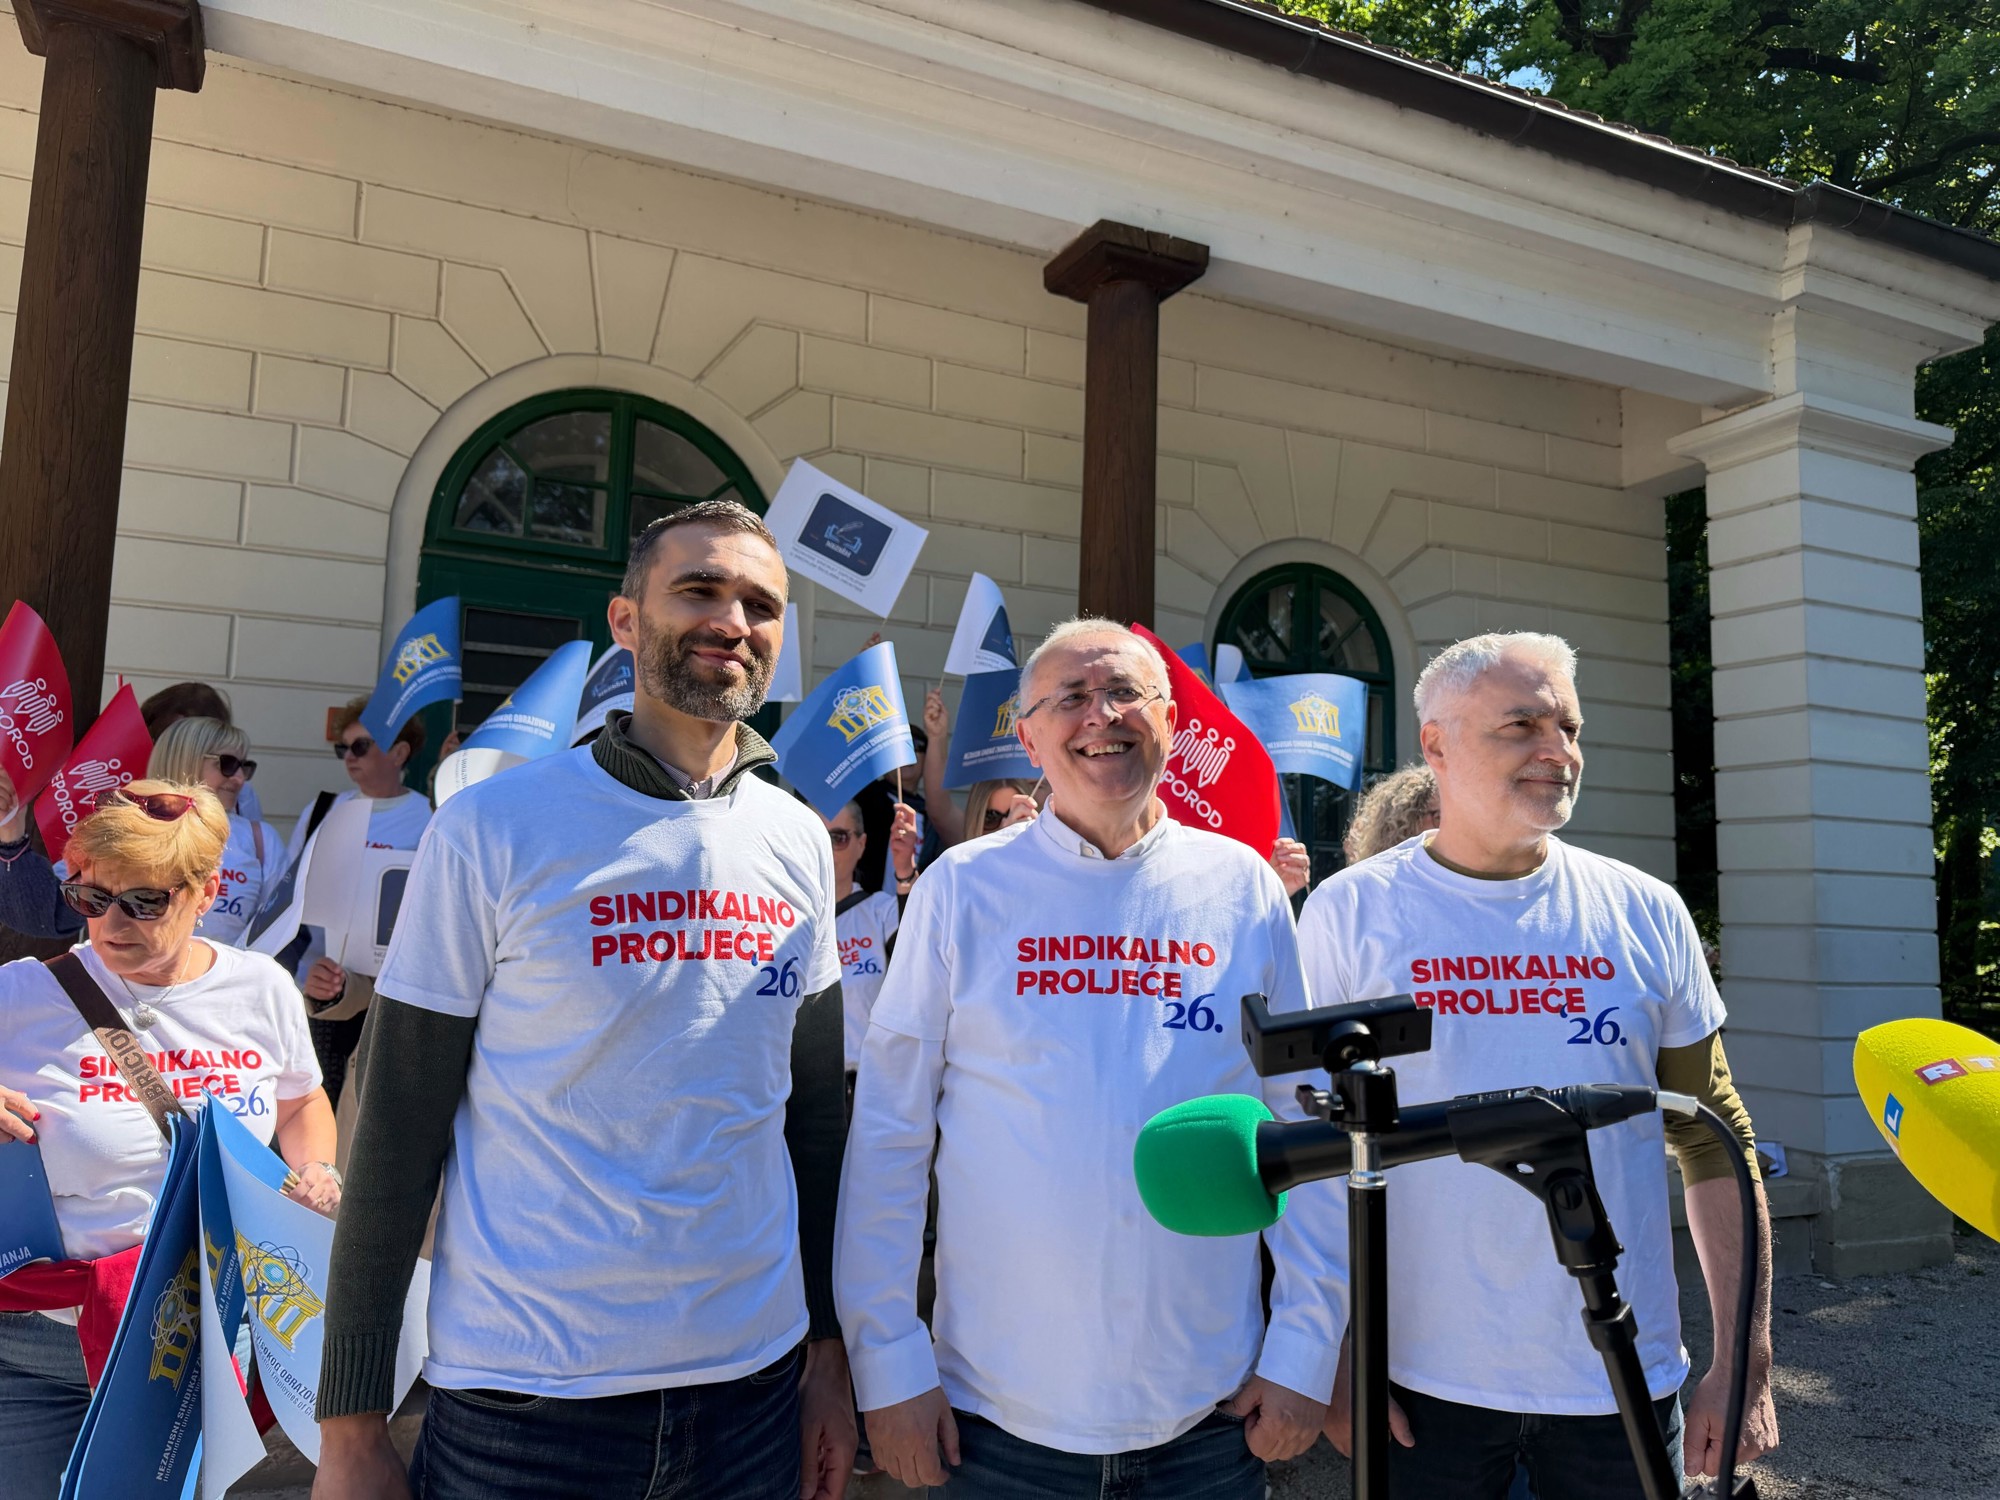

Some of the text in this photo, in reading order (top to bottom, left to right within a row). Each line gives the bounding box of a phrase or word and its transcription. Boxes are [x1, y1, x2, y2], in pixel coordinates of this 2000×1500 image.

[1159, 768, 1223, 829] POROD
[589, 889, 796, 928] SINDIKALNO
[592, 923, 775, 966] PROLJEĆE
[1016, 935, 1217, 968] SINDIKALNO
[1016, 964, 1182, 998] PROLJEĆE
[1411, 955, 1616, 984] SINDIKALNO
[1413, 981, 1587, 1016] PROLJEĆE
[280, 1369, 317, 1406] OBRAZOV
[156, 1369, 200, 1480] NEZAVISNI SINDIKAT
